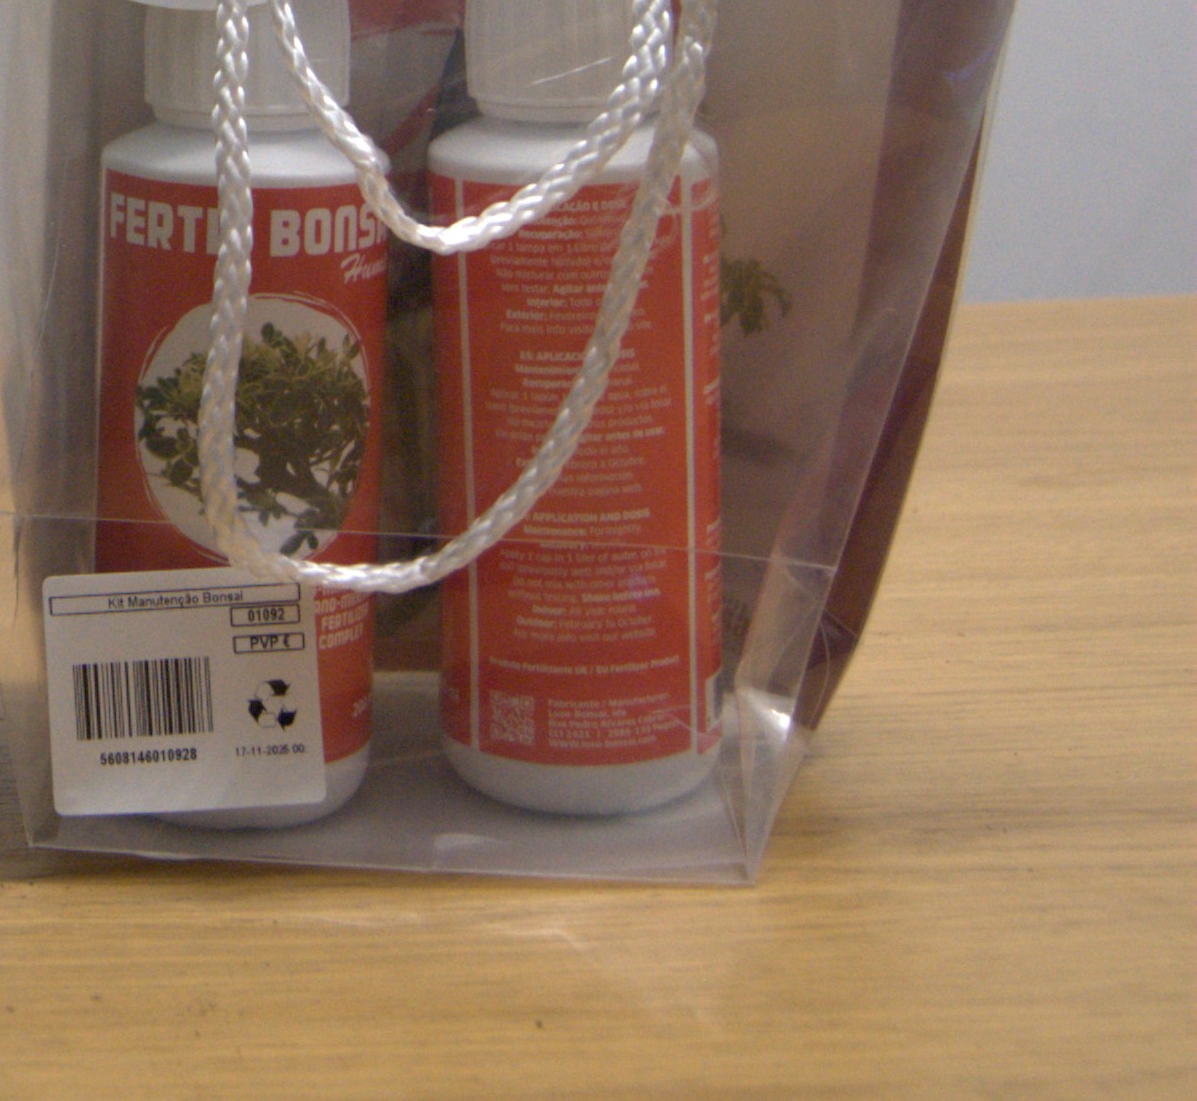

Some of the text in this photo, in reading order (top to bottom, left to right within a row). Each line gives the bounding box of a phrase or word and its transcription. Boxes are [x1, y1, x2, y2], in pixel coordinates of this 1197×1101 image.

[107, 596, 124, 609] Kit
[127, 592, 200, 608] Manutenção
[247, 608, 285, 622] 01092
[249, 635, 279, 649] PVP
[99, 747, 198, 766] 5608146010928
